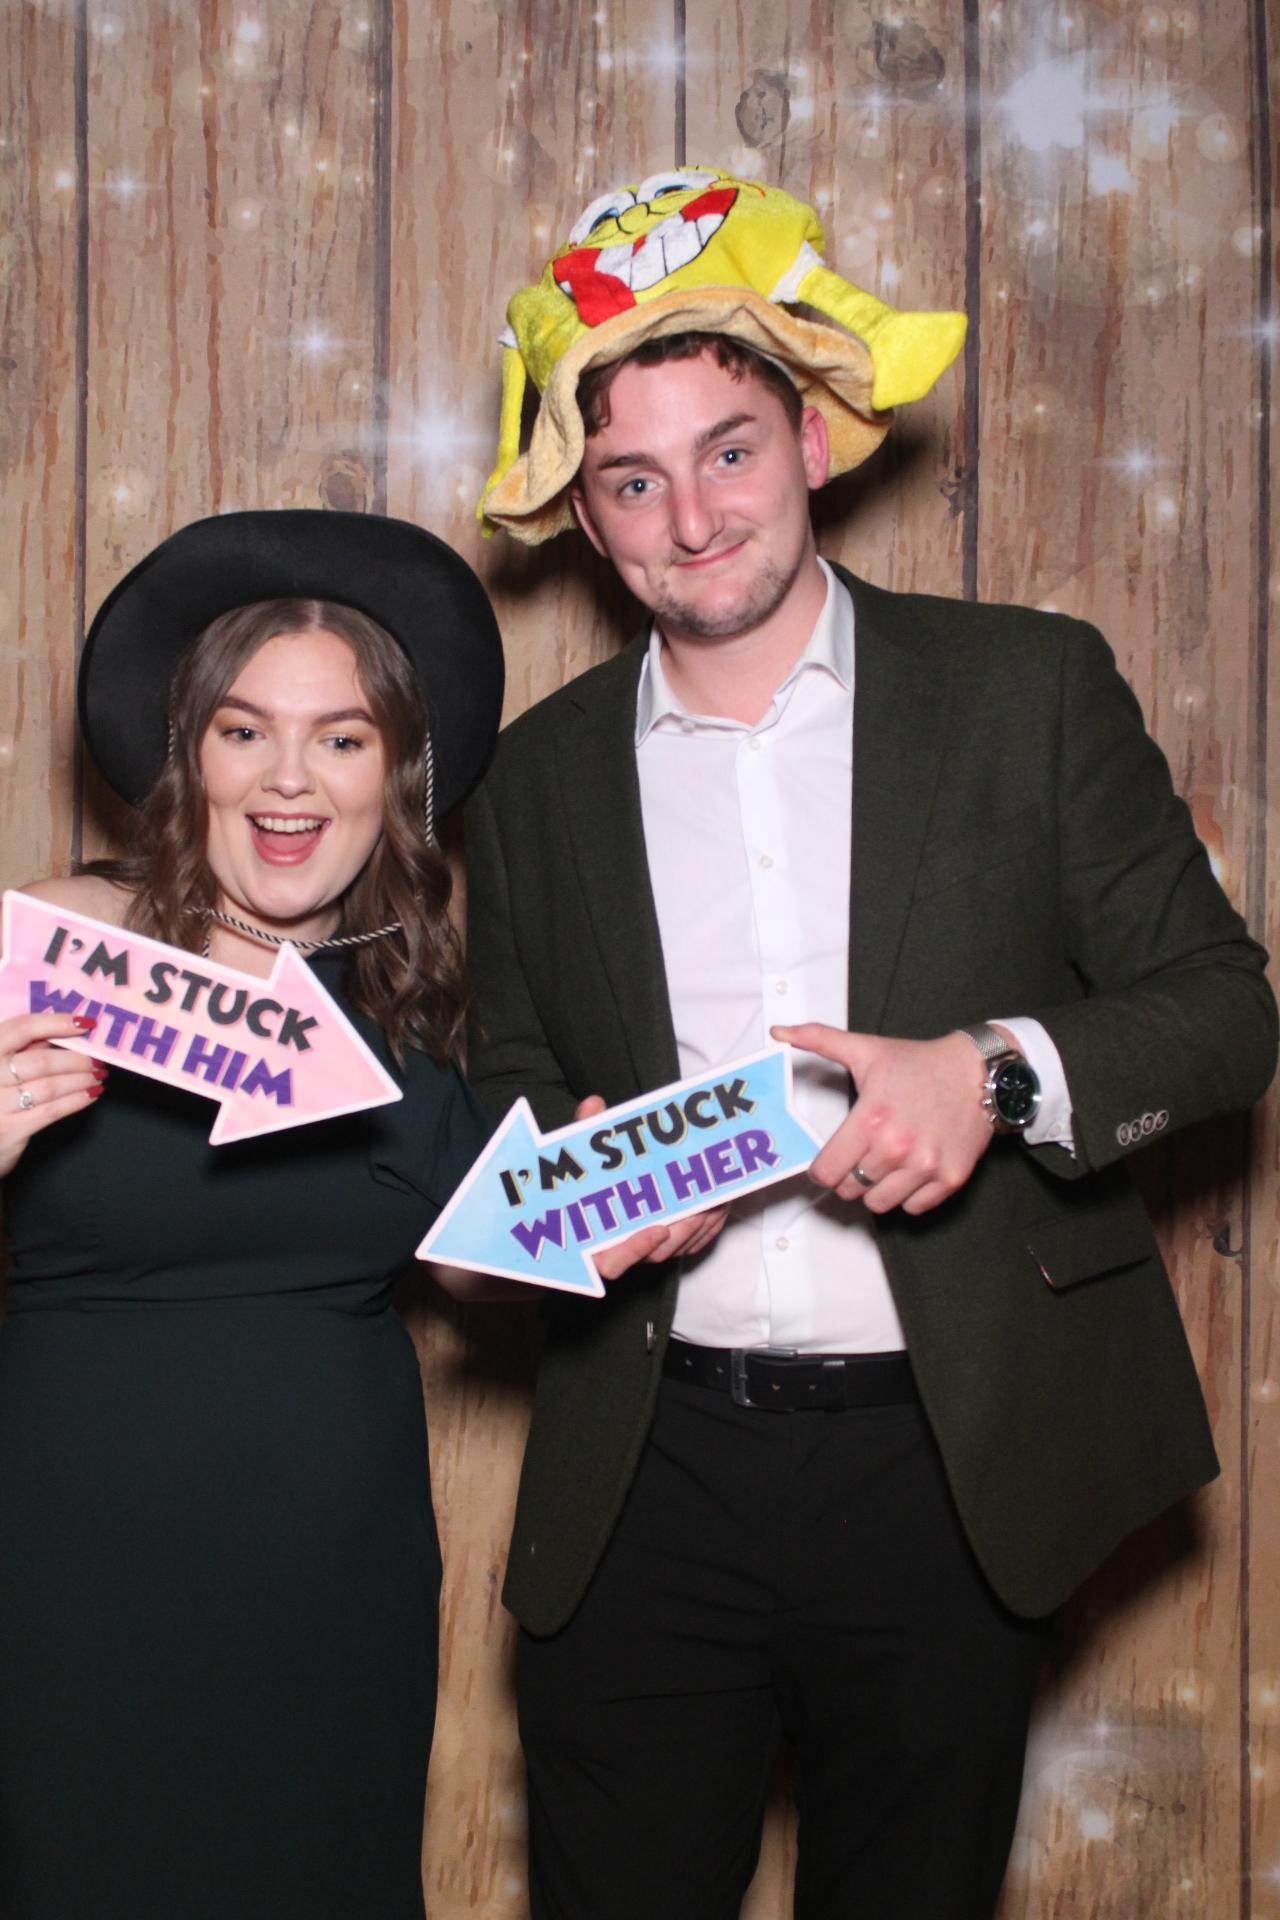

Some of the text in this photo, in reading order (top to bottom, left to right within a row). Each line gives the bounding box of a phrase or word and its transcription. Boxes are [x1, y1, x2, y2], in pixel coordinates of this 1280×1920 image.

[29, 980, 294, 1106] WITH HIM
[44, 926, 318, 1052] I'M STUCK
[499, 1077, 757, 1208] I'M STUCK
[510, 1129, 781, 1262] WITH HER
